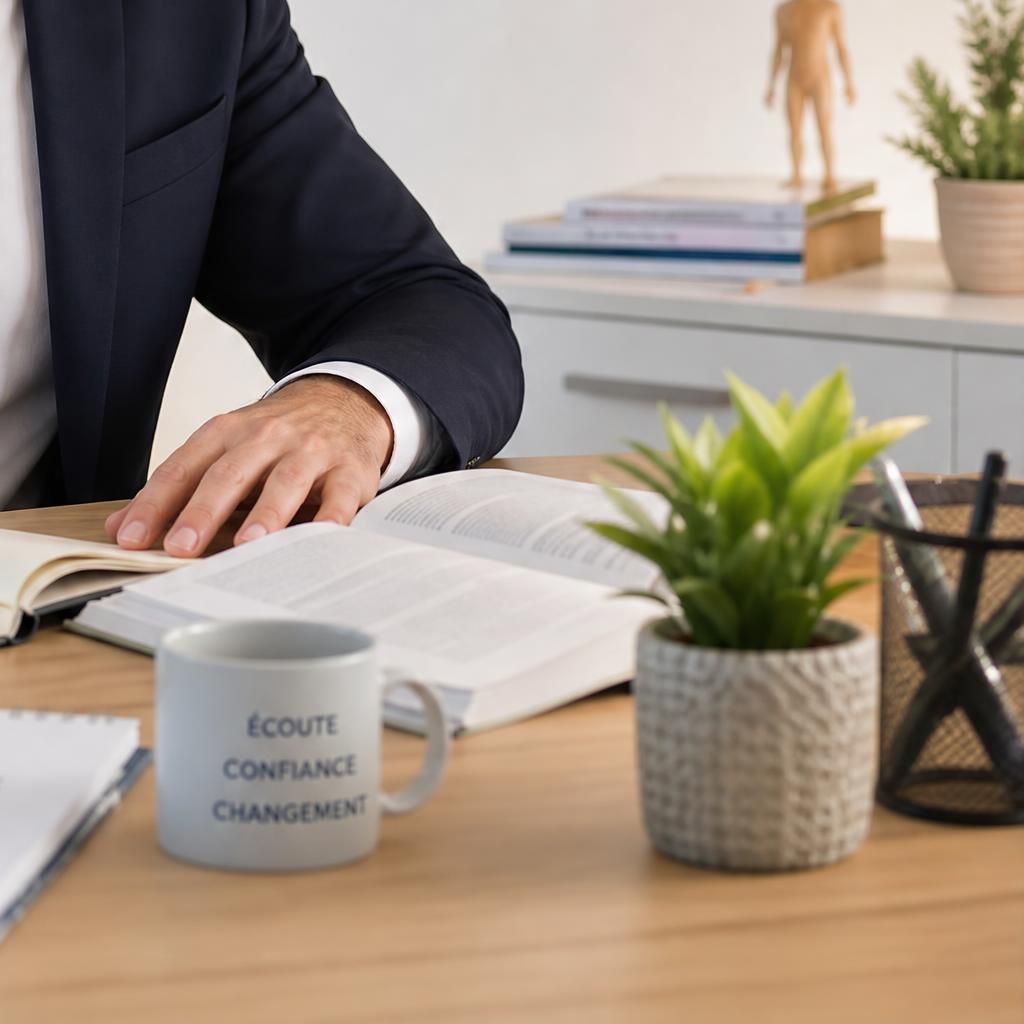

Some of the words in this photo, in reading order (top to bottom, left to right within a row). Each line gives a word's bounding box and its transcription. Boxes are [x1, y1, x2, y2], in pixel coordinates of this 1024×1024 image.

[248, 710, 338, 739] ÉCOUTE
[223, 754, 357, 782] CONFIANCE
[212, 795, 367, 826] CHANGEMENT
